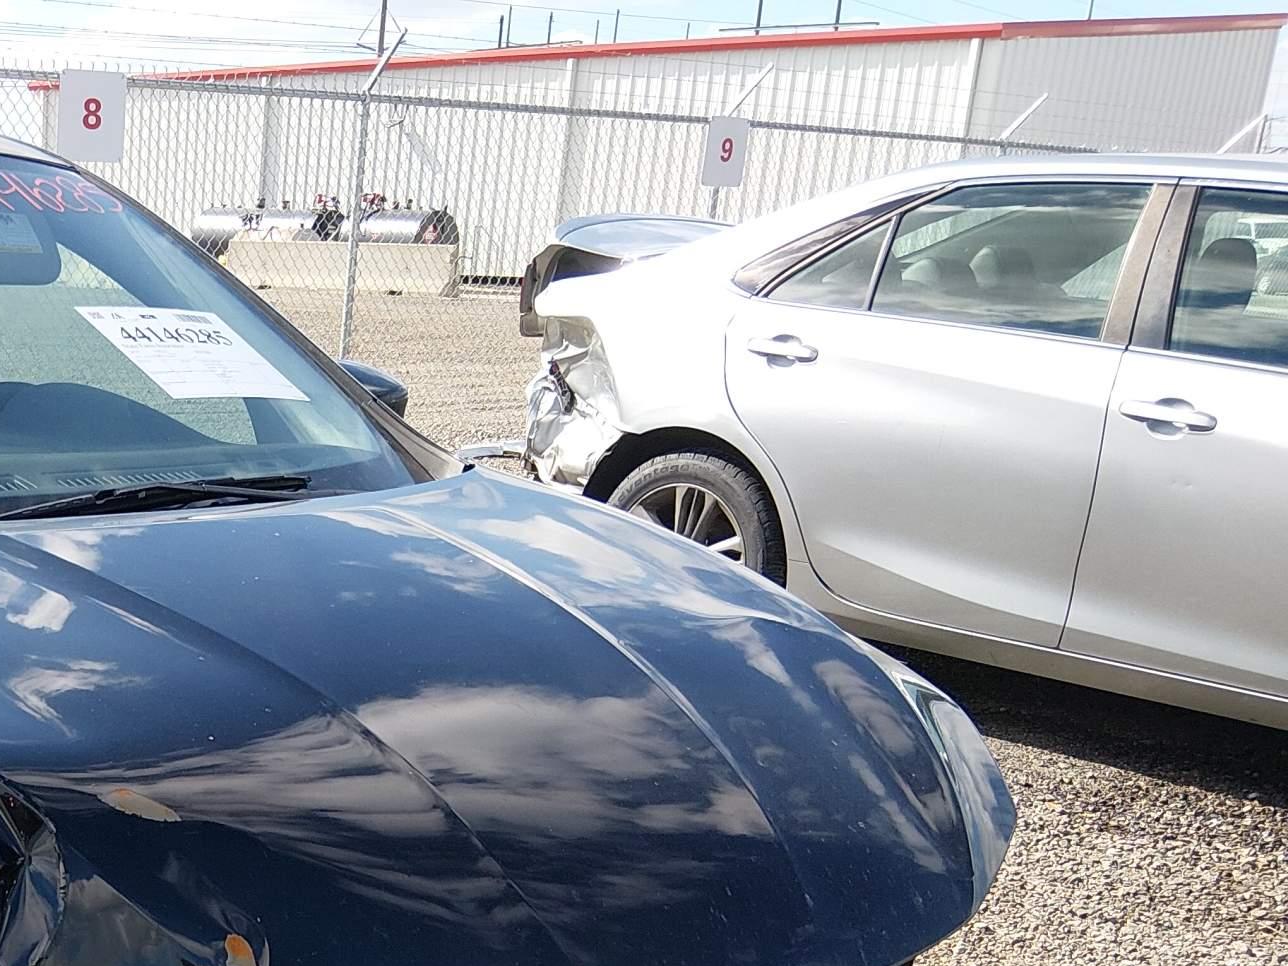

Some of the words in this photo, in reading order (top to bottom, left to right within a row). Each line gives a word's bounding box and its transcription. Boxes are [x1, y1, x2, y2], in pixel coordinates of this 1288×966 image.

[82, 98, 102, 130] 8
[720, 137, 734, 163] 9
[120, 326, 233, 346] 44146285
[617, 463, 691, 503] dvantage
